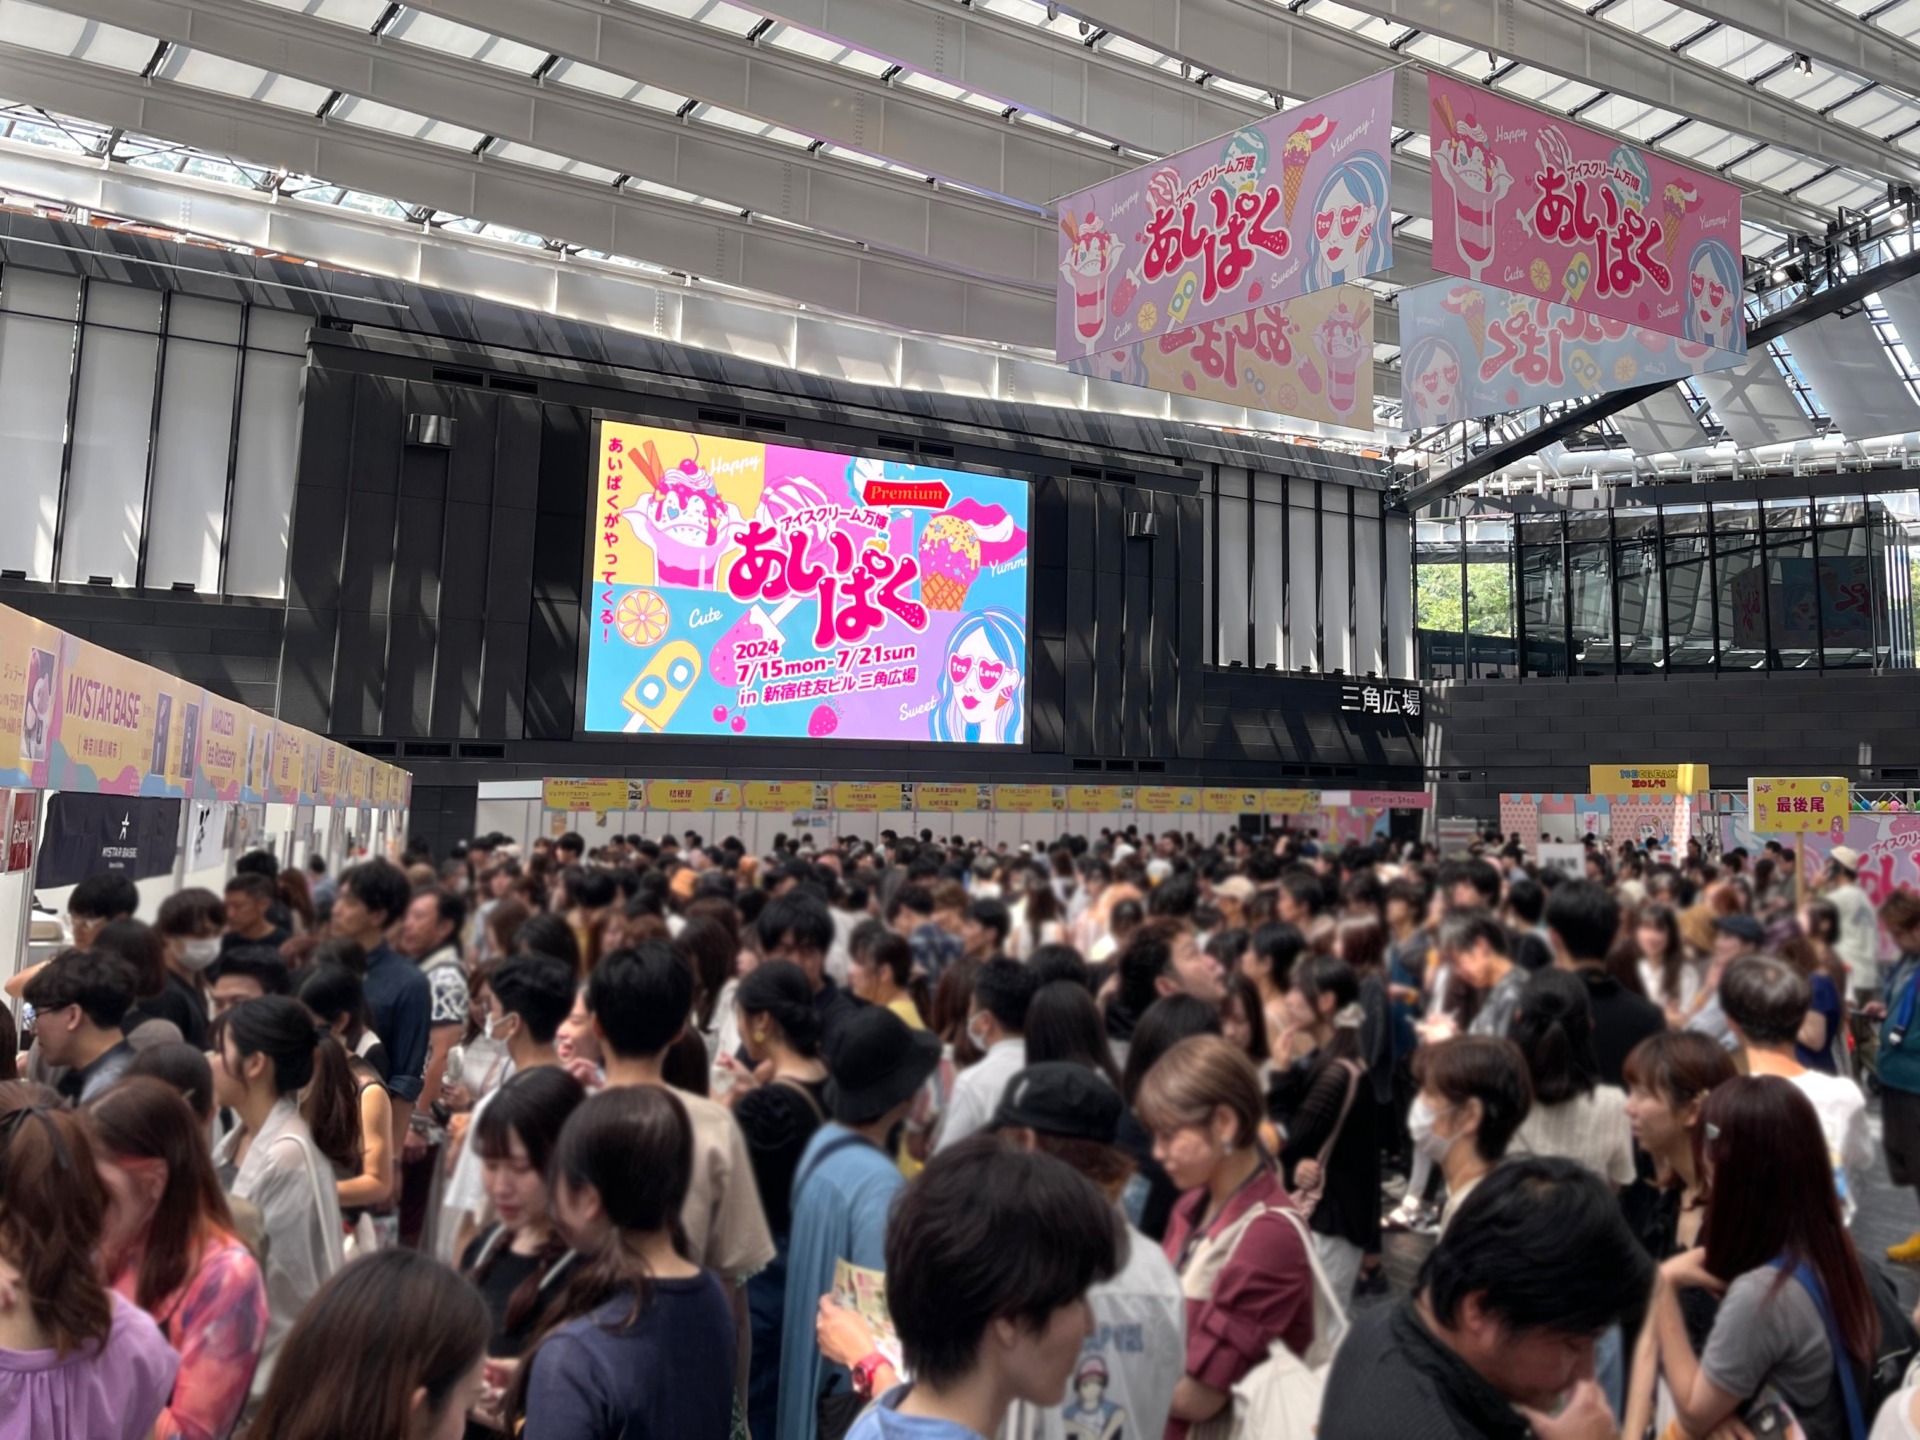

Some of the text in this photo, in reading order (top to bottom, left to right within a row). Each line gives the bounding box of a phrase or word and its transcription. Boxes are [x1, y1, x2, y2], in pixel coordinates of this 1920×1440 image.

[1330, 108, 1375, 157] Yummy!
[1495, 125, 1528, 144] Happy
[1176, 155, 1256, 208] アイスクリーム万博
[1567, 162, 1641, 192] アイスクリーム万博
[1110, 192, 1140, 222] Happy
[1699, 209, 1731, 230] Yummy!
[1318, 214, 1360, 230] Ice Love
[1536, 166, 1671, 294] あいぱく
[1143, 187, 1291, 303] あいぱく
[1271, 259, 1300, 289] Sweet
[1503, 265, 1525, 282] Cute
[1656, 301, 1681, 319] Sweet
[1113, 321, 1133, 342] Cute
[708, 454, 761, 477] Happy
[871, 485, 943, 501] Premium
[780, 506, 889, 532] アイスクリーム万博
[600, 437, 624, 643] あいぱくがやってくる!
[728, 521, 928, 648] あいぱく
[688, 607, 724, 629] Cute
[735, 639, 780, 660] 2024
[952, 662, 1001, 679] Ice Love
[739, 667, 917, 706] in 新宿住友ビル 三角広場
[66, 673, 141, 730] MYSTAR BASE
[899, 695, 938, 721] Sweet
[1341, 686, 1421, 716] 三角広場
[1776, 796, 1825, 813] 最後尾
